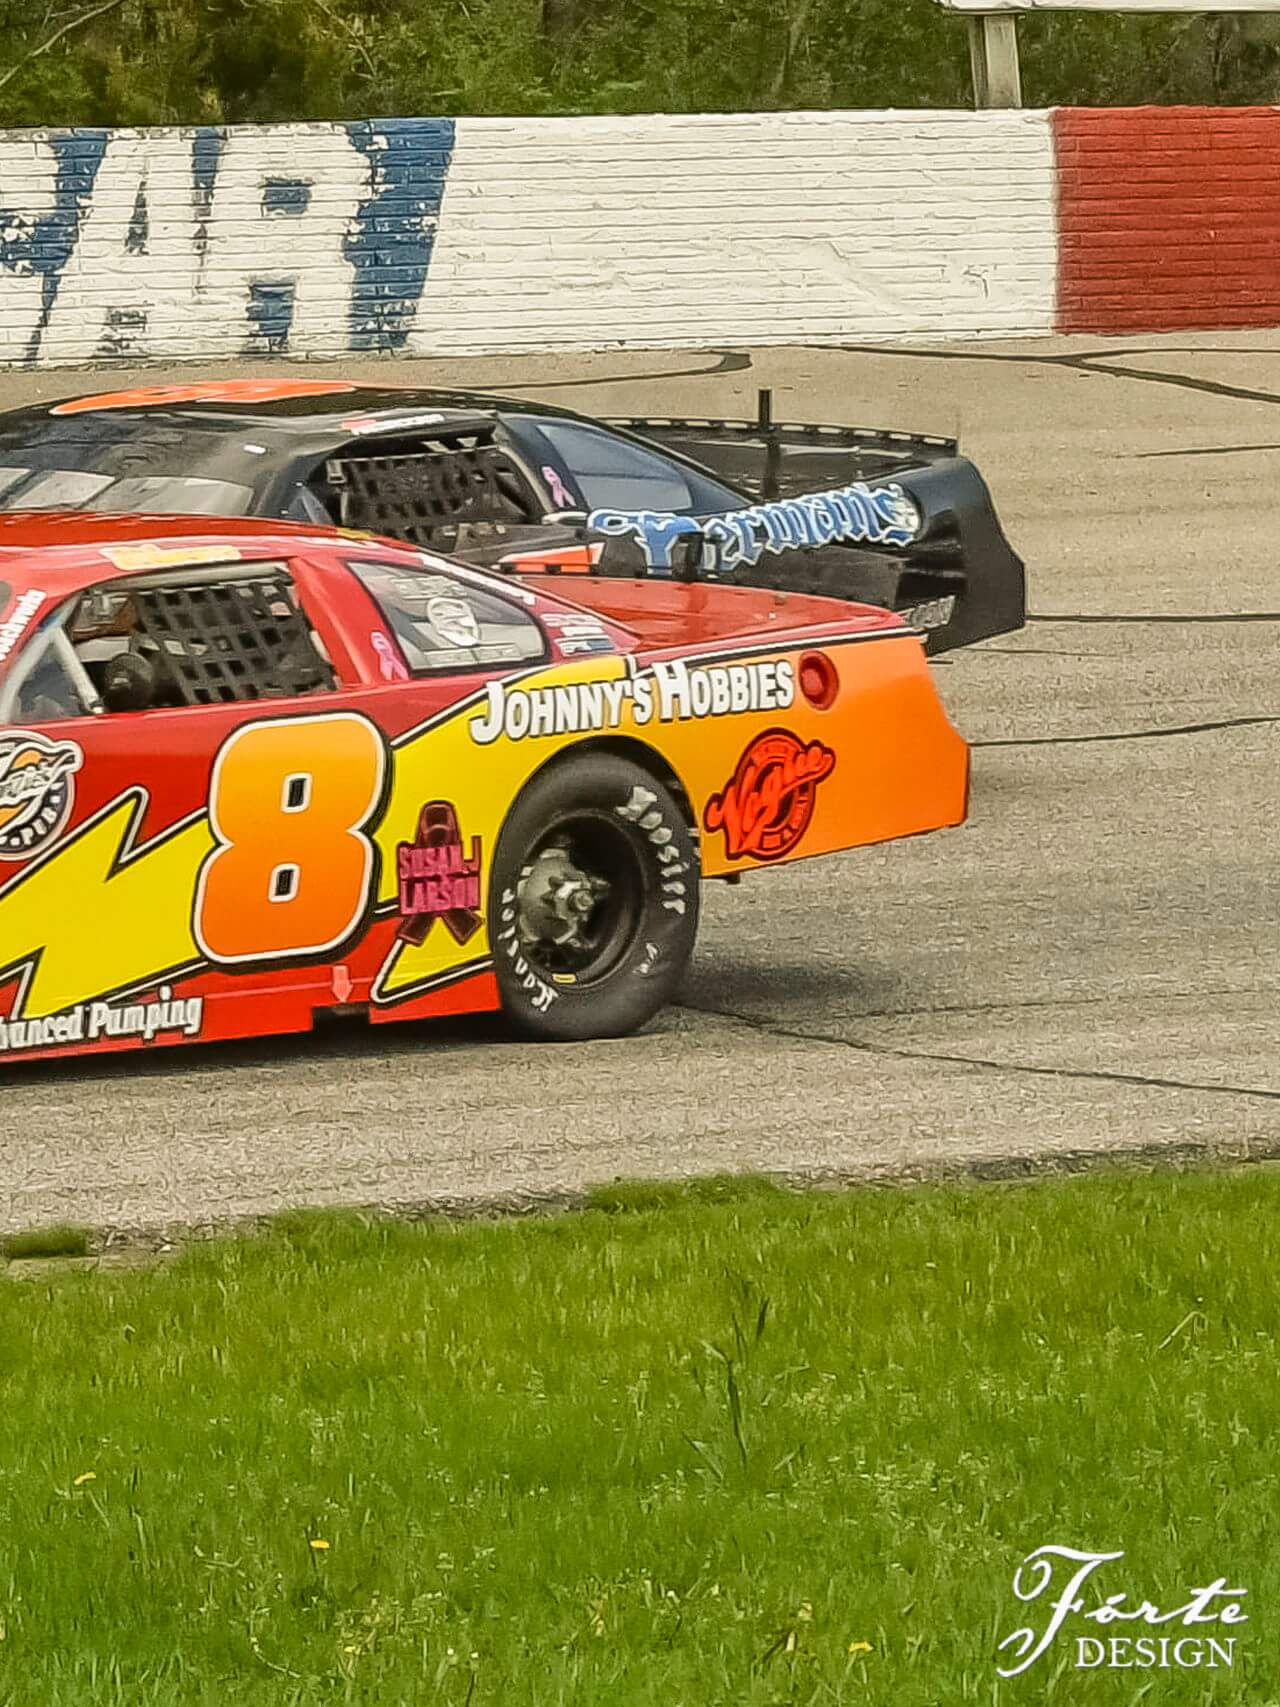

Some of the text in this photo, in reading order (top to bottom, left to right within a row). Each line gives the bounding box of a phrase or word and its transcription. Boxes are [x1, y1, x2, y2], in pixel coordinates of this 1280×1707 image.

[652, 660, 795, 723] HOBBIES
[191, 710, 388, 966] 8
[87, 985, 203, 1040] Pumping
